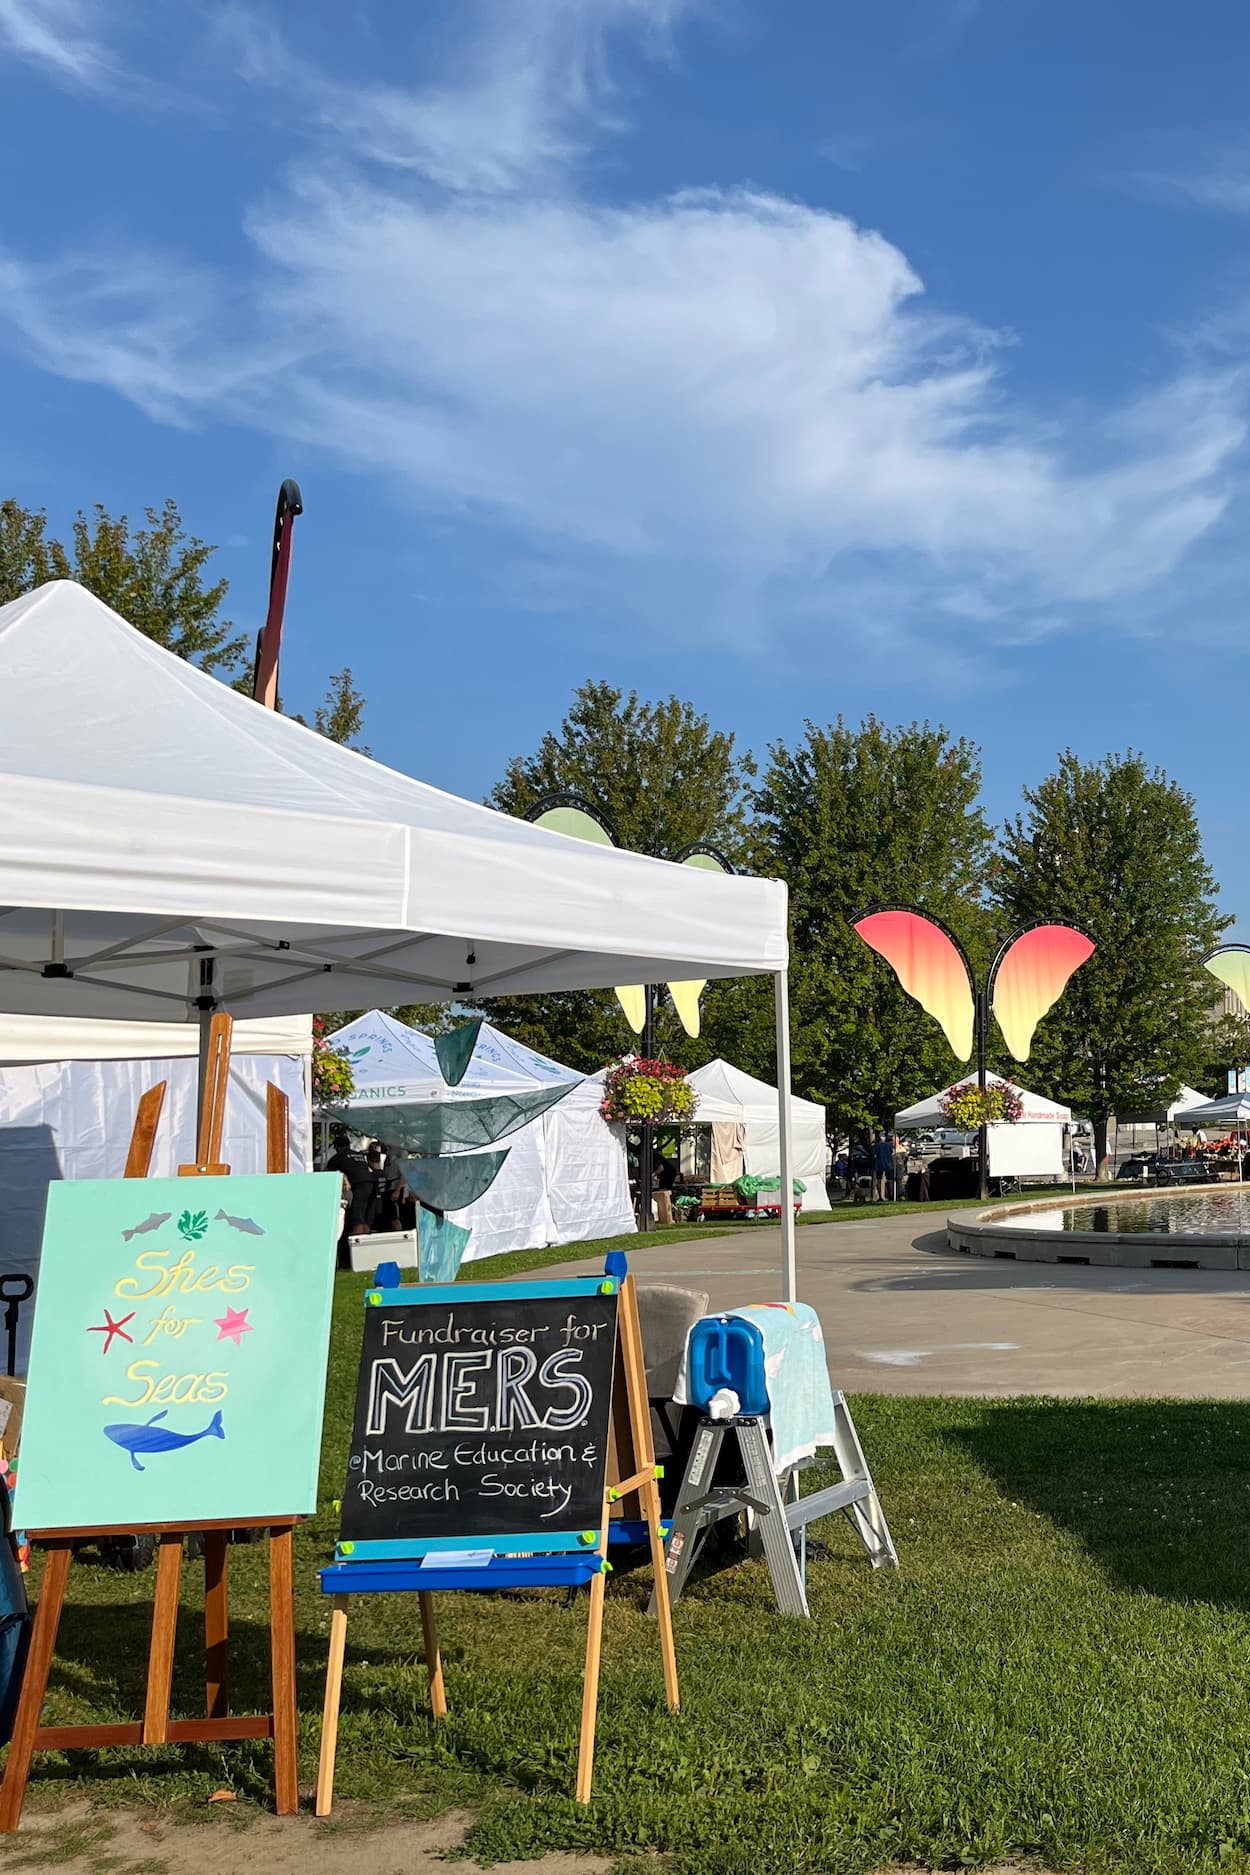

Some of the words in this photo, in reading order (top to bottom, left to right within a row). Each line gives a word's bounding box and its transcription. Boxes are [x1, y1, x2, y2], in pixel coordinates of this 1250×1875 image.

[114, 1249, 255, 1300] Shes
[143, 1305, 203, 1344] for
[381, 1312, 549, 1346] Fundraiser
[560, 1314, 608, 1347] for
[102, 1360, 230, 1407] Seas
[454, 1440, 577, 1467] Education
[357, 1478, 460, 1507] Research
[478, 1473, 573, 1518] Society
